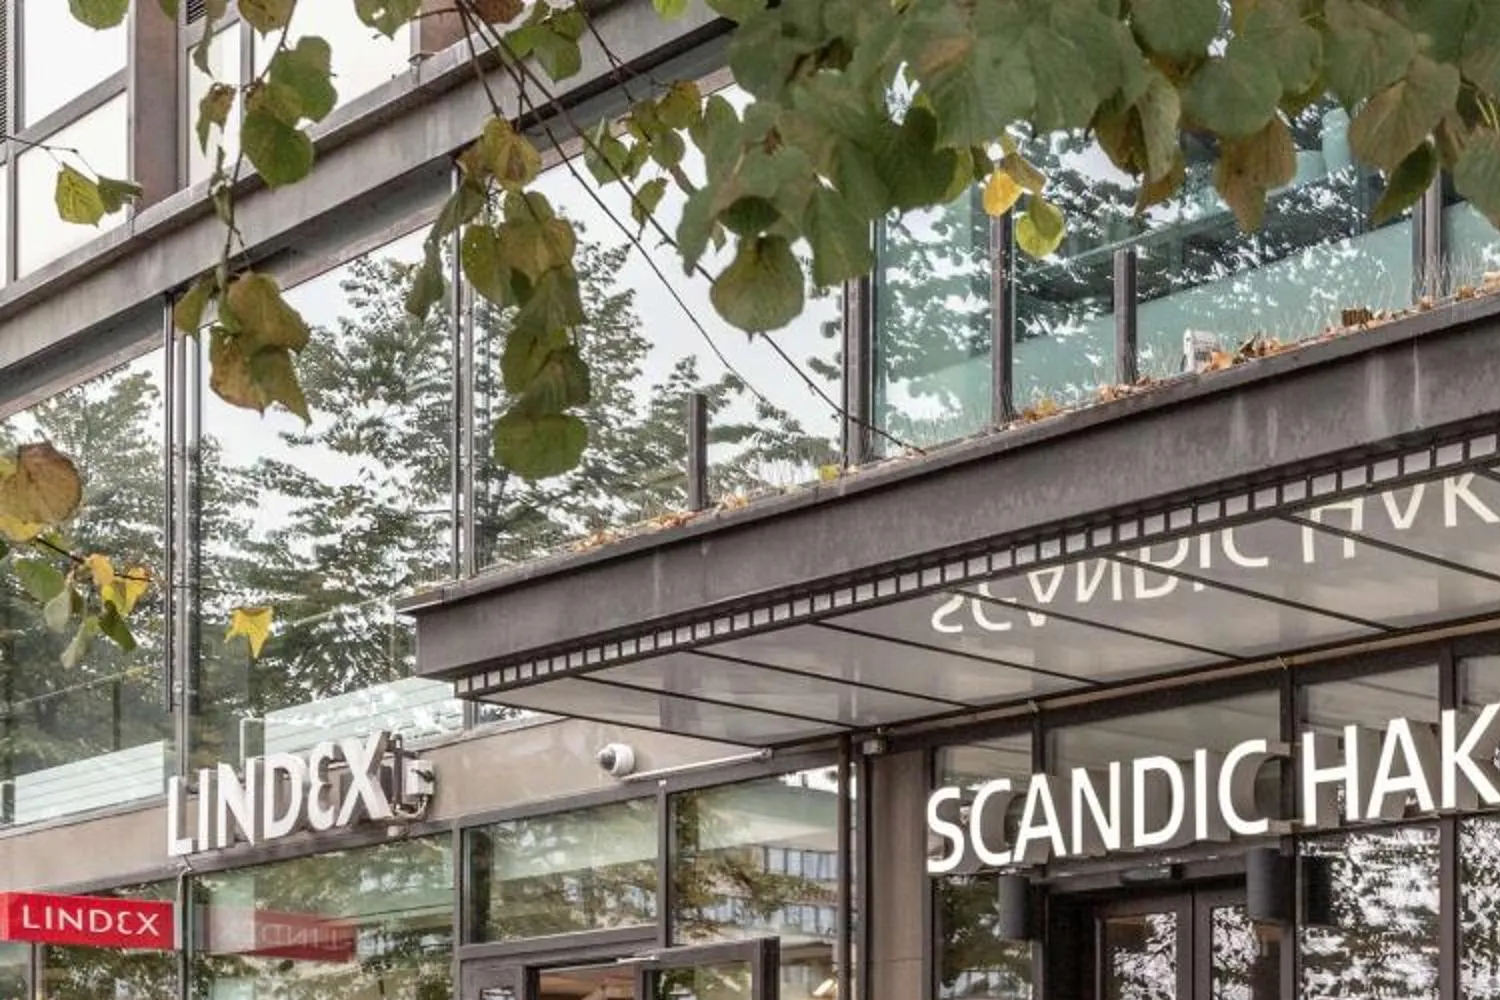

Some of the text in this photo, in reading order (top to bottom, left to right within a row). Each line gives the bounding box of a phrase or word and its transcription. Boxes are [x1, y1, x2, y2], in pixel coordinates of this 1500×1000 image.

[168, 730, 392, 856] LINDEX
[927, 739, 1269, 873] SCANDIC
[22, 904, 160, 937] LINDEX
